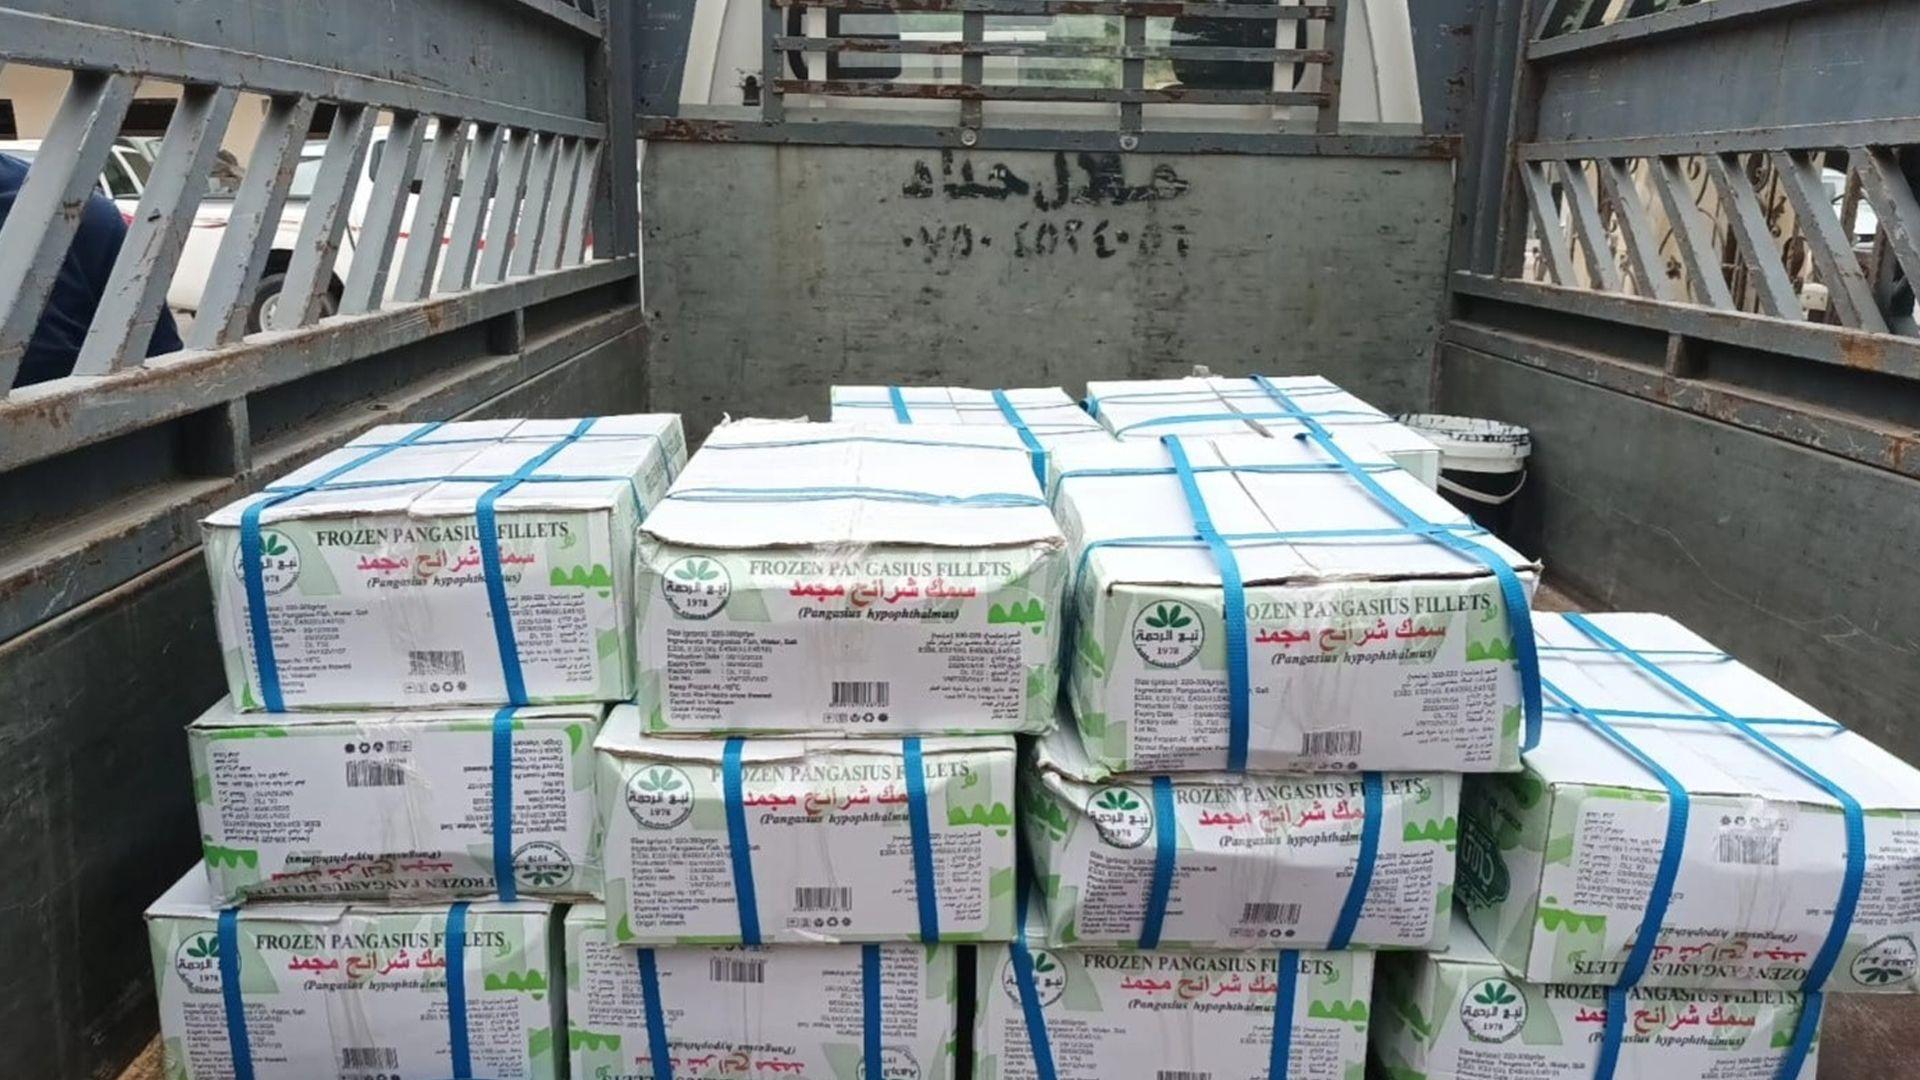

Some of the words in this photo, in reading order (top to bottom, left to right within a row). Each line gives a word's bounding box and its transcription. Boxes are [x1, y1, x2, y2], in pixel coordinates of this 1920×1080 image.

[317, 529, 388, 546] FROZEN
[393, 525, 480, 544] PANGASIU
[498, 521, 569, 540] FILLETS
[357, 555, 408, 574] مجمد
[750, 560, 824, 576] FROZEN
[828, 561, 930, 577] PANGASIUS
[937, 561, 1012, 577] FILLETS
[790, 579, 844, 602] مجمد
[926, 576, 976, 599] سمك
[798, 607, 862, 623] (Pangasius
[868, 606, 960, 623] hypophthalmus)
[1223, 599, 1299, 620] OZEN
[1303, 596, 1410, 619] PANGASIUS
[1416, 593, 1490, 613] FILLETS
[1254, 624, 1311, 648] مجمد
[1395, 619, 1447, 639] سمك
[1271, 651, 1339, 668] (Pangasius
[1343, 646, 1438, 667] hypophthalmus)
[790, 765, 891, 782] PANGASIUS
[896, 761, 969, 778] FLETS
[743, 789, 797, 811] مجمد
[1177, 784, 1238, 804] ROZEN
[1243, 782, 1345, 801] PANGASIUS
[425, 877, 495, 890] FROZEN
[257, 934, 325, 950] FROZEN
[332, 933, 430, 949] PANGASIUS
[433, 931, 505, 948] FLETS
[1084, 954, 1155, 970] FROZEN
[1159, 955, 1256, 973] PANGASIUS
[1753, 946, 1807, 963] مجمد
[288, 955, 338, 975] مجمد
[1754, 966, 1807, 982] OZEN
[1121, 976, 1172, 995] مجمد
[1544, 984, 1608, 999] FROZE
[1128, 999, 1188, 1013] (Pangasius
[1706, 1003, 1756, 1027] سمك
[1575, 1008, 1608, 1029] جمد
[756, 1058, 804, 1073] مجمد
